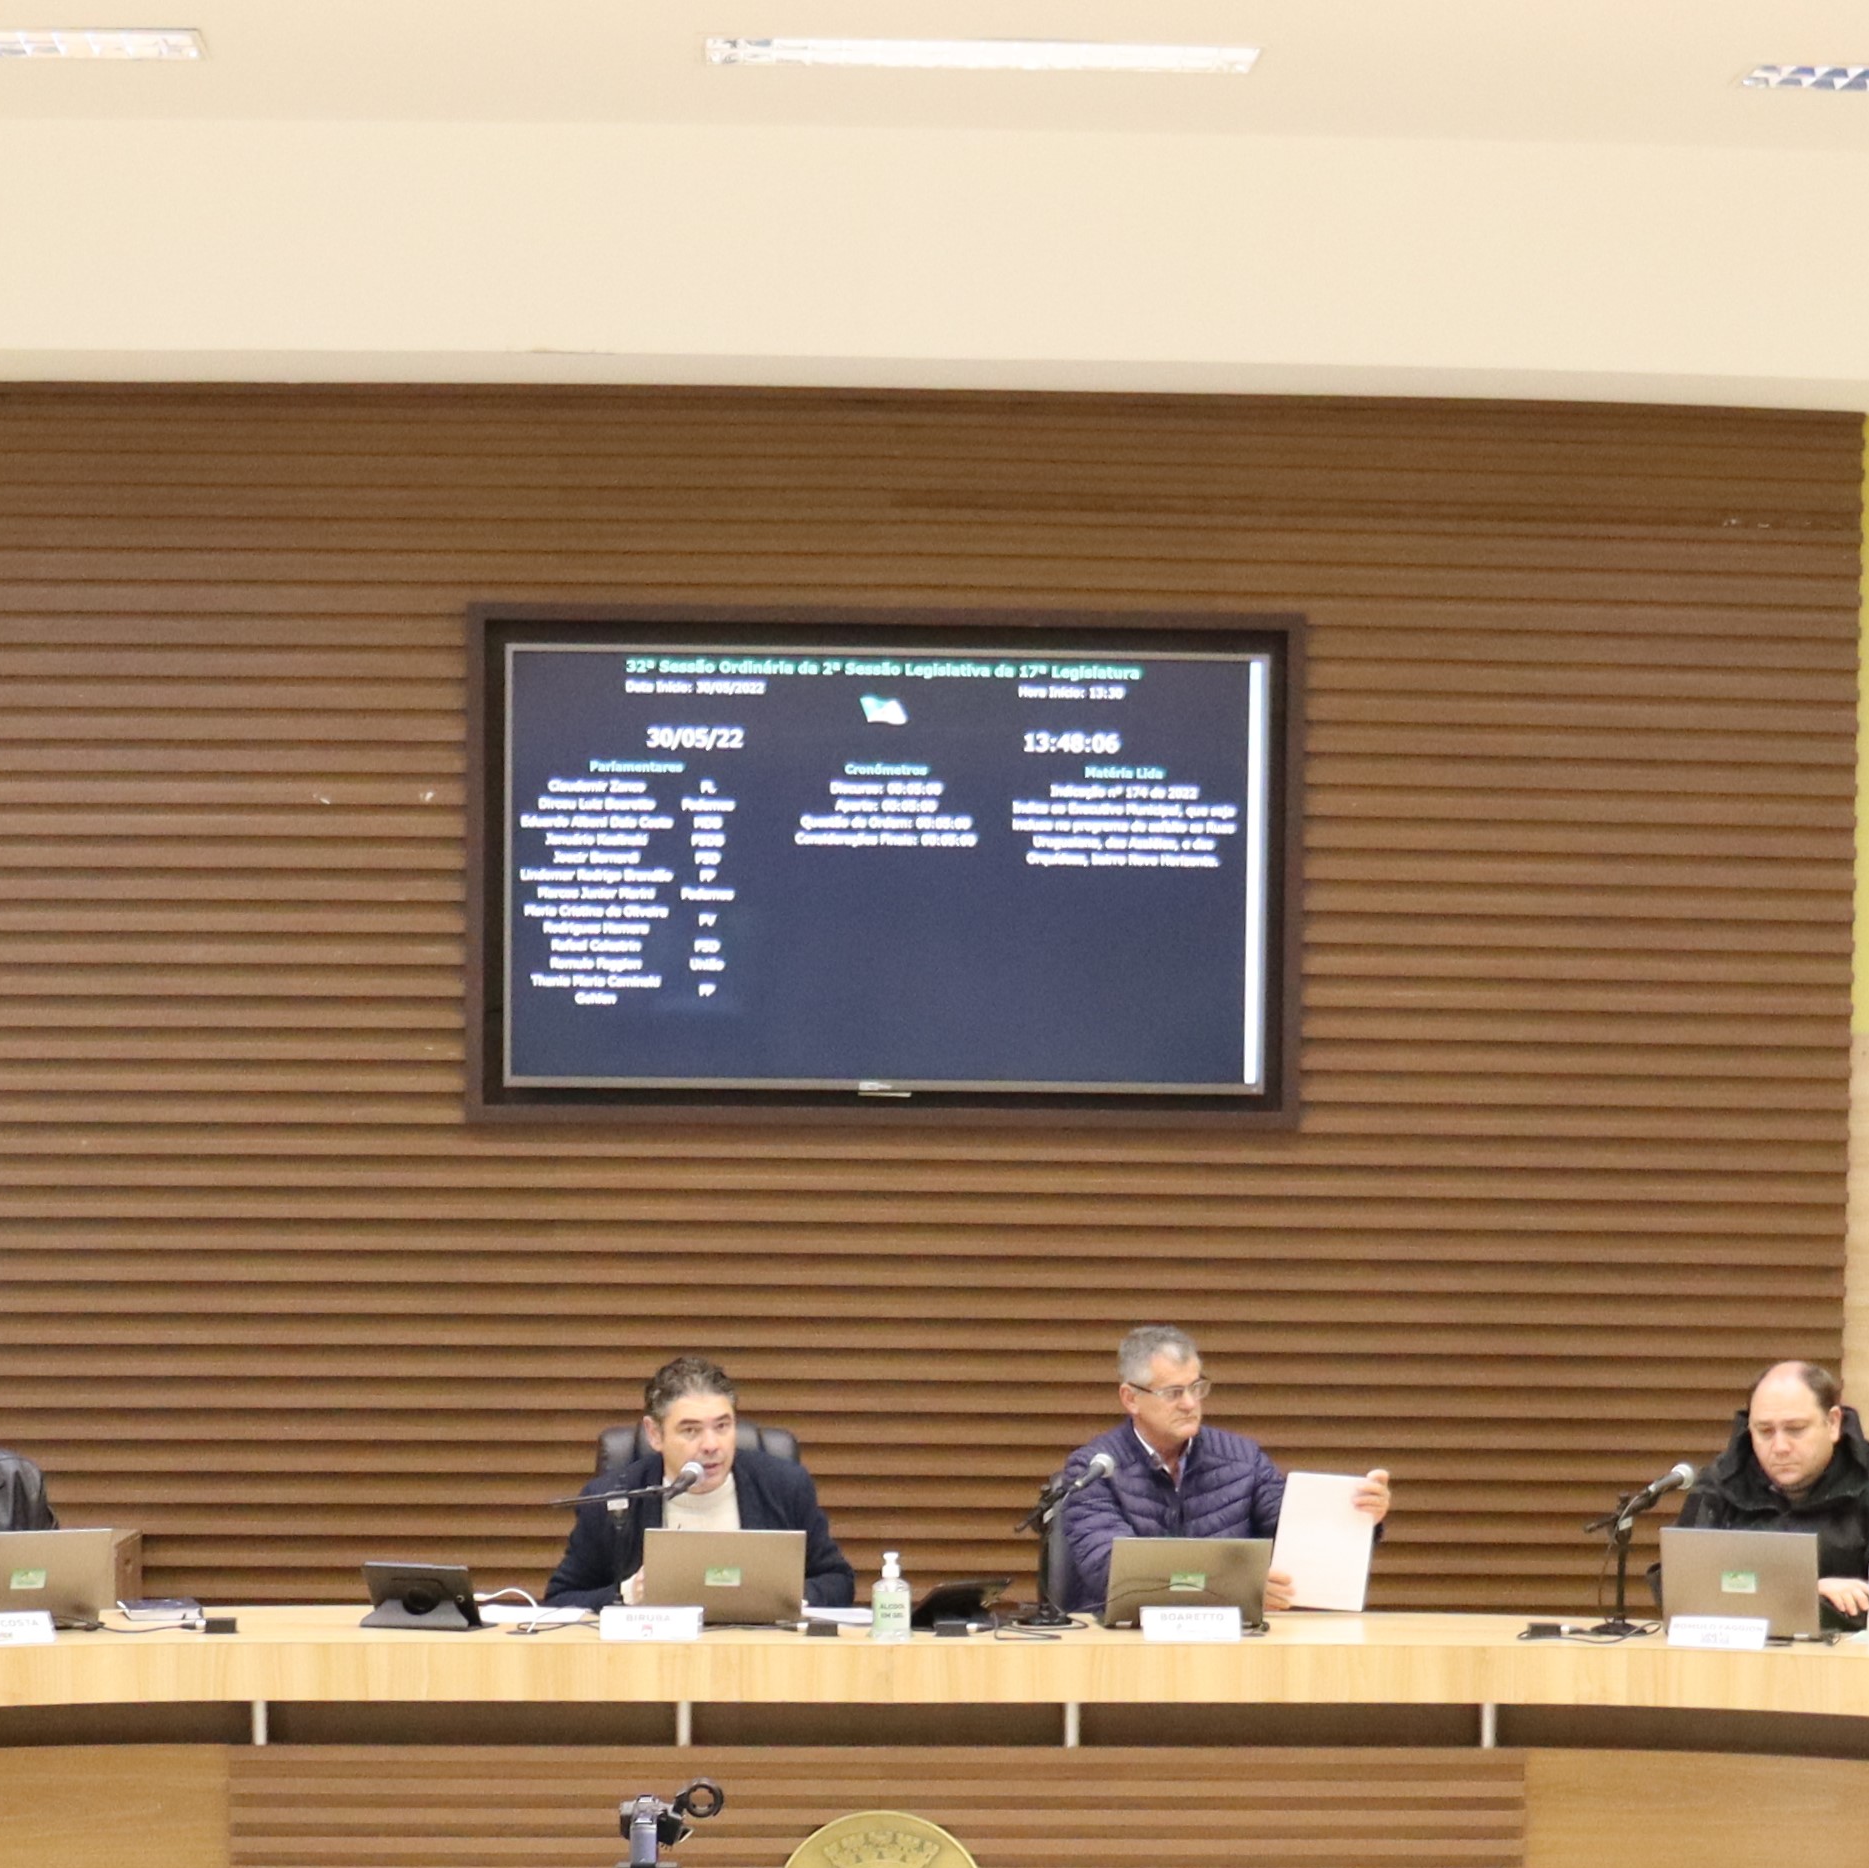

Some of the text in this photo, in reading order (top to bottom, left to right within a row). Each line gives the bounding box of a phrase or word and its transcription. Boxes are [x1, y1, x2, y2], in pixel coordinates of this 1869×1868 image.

[626, 658, 1142, 681] 32ª Sessão Ordinária da 2ª Sessão Legislativa da 17ª Legislatura
[625, 679, 655, 693] Data
[696, 680, 766, 695] 30/05/2022
[1018, 685, 1048, 698] Hora
[647, 726, 744, 750] 30/05/22
[1024, 731, 1121, 754] 13:48:06
[590, 760, 684, 773] Parlamentares
[845, 763, 929, 776] Cronômetros
[1085, 766, 1165, 779] Matéria Lida
[1168, 785, 1199, 799] 2022
[0, 1617, 39, 1628] COSTA
[626, 1613, 670, 1622] BIRUBA
[1160, 1612, 1224, 1621] BOARETTO
